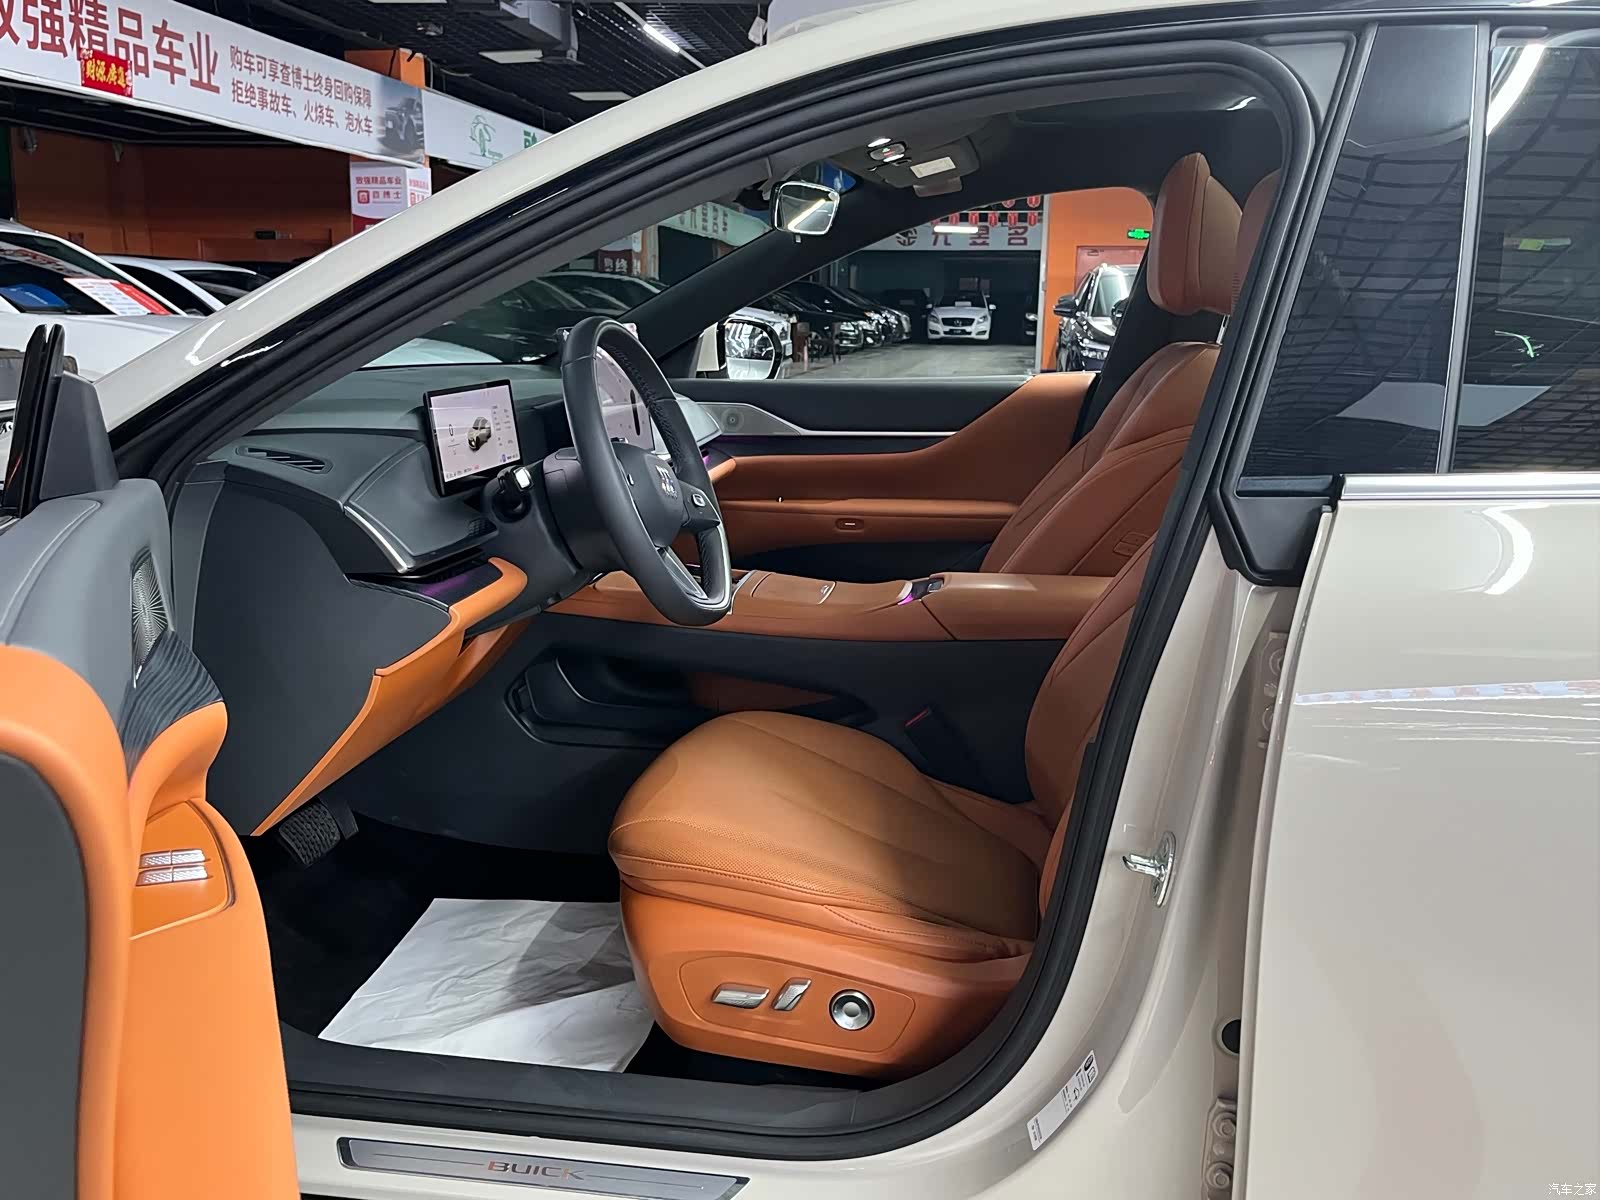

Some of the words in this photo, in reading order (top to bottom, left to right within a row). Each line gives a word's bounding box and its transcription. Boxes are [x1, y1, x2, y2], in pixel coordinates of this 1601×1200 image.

[230, 45, 373, 110] 购车可享查博士终身回购保障
[231, 77, 374, 136] 拒绝事故车、火烧车、泡水车
[488, 1160, 585, 1181] BUICK
